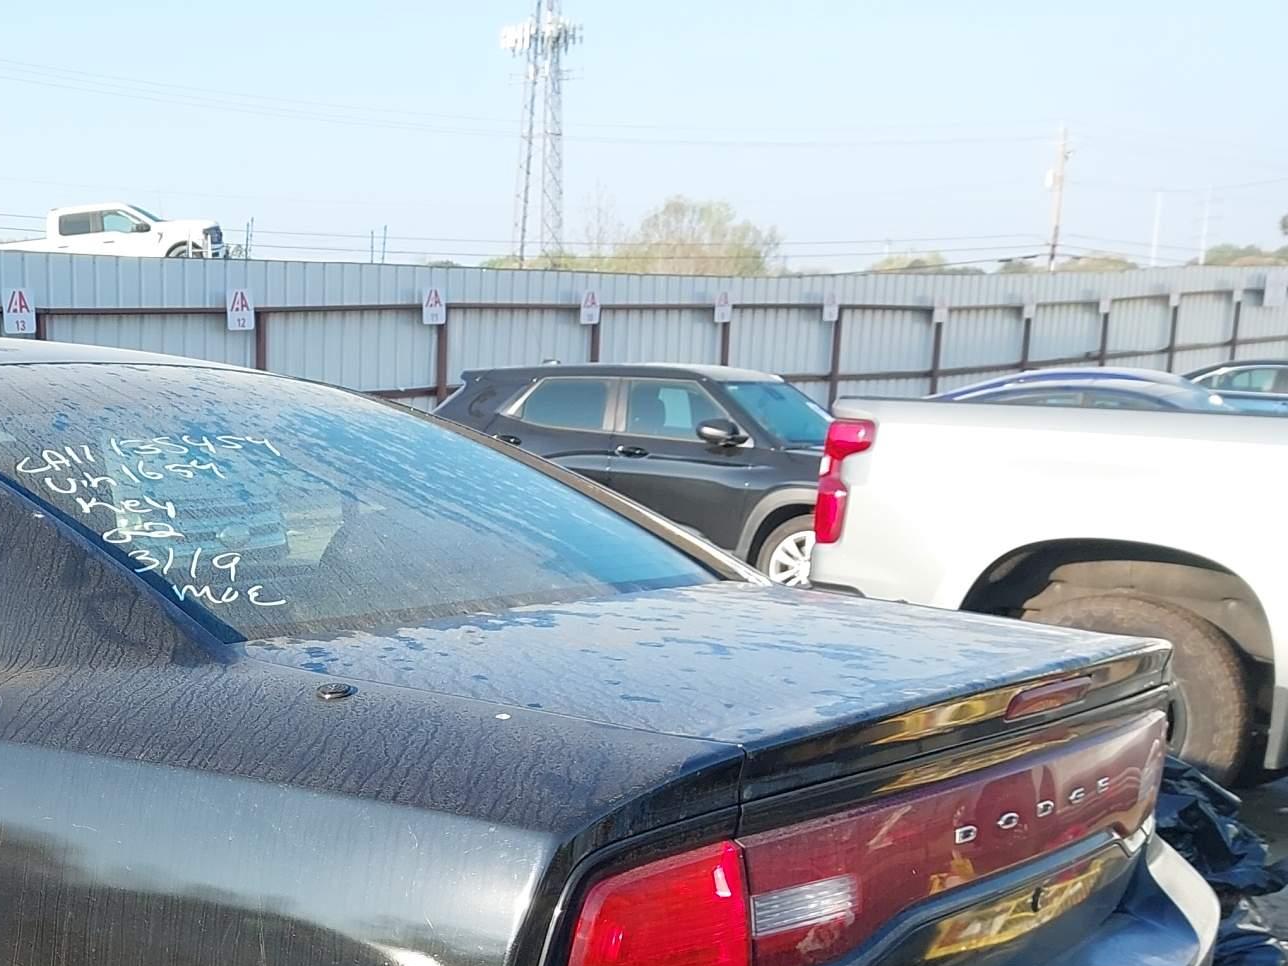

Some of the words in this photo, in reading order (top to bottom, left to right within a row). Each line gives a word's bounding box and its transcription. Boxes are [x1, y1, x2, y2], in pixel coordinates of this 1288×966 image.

[15, 320, 26, 331] 13
[236, 318, 246, 328] 12
[121, 460, 226, 483] 1654
[955, 776, 1110, 844] DODGE
